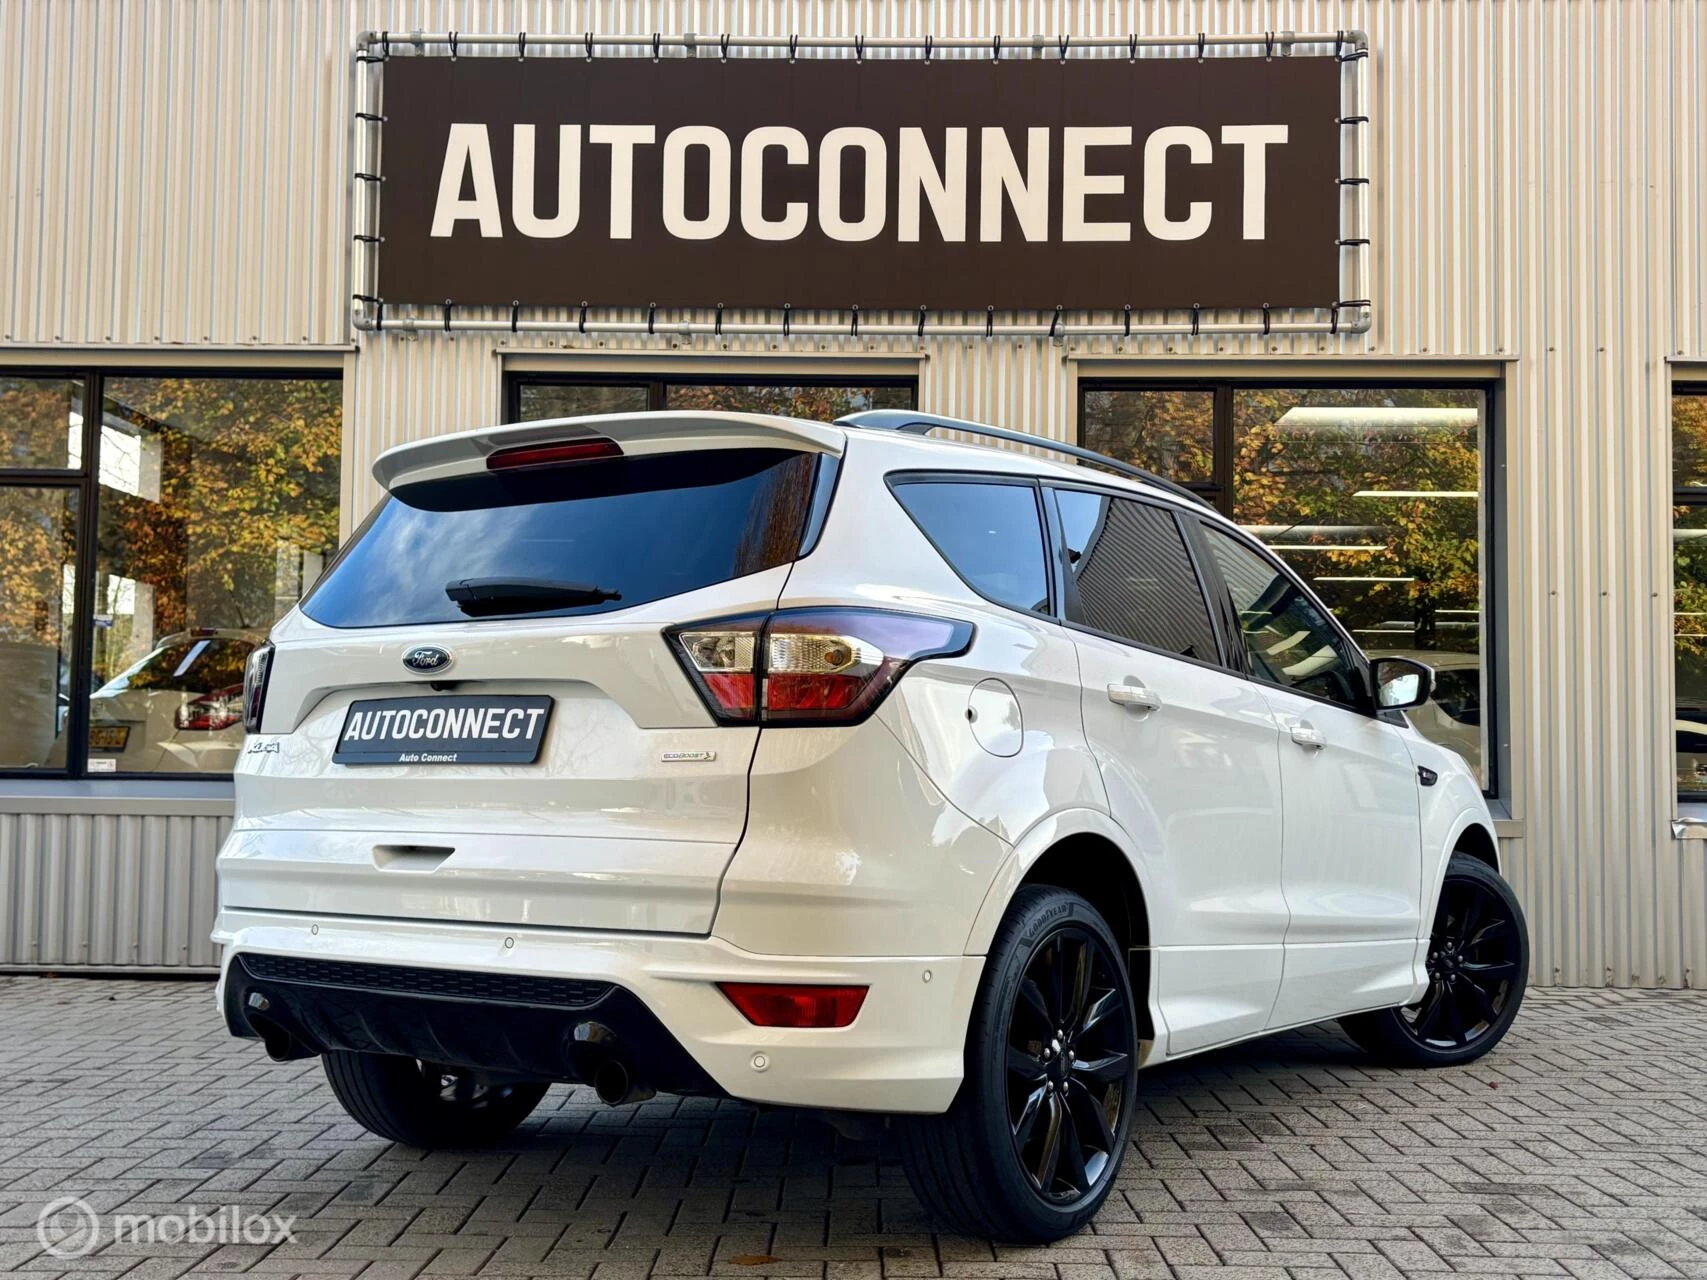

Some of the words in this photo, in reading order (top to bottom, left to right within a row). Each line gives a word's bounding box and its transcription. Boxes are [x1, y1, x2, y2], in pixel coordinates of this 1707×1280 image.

[430, 123, 1289, 242] AUTOCONNECT
[411, 650, 439, 667] Ford
[344, 708, 545, 741] AUTOCONNECT
[399, 753, 419, 762] Auto
[421, 753, 457, 762] Connect
